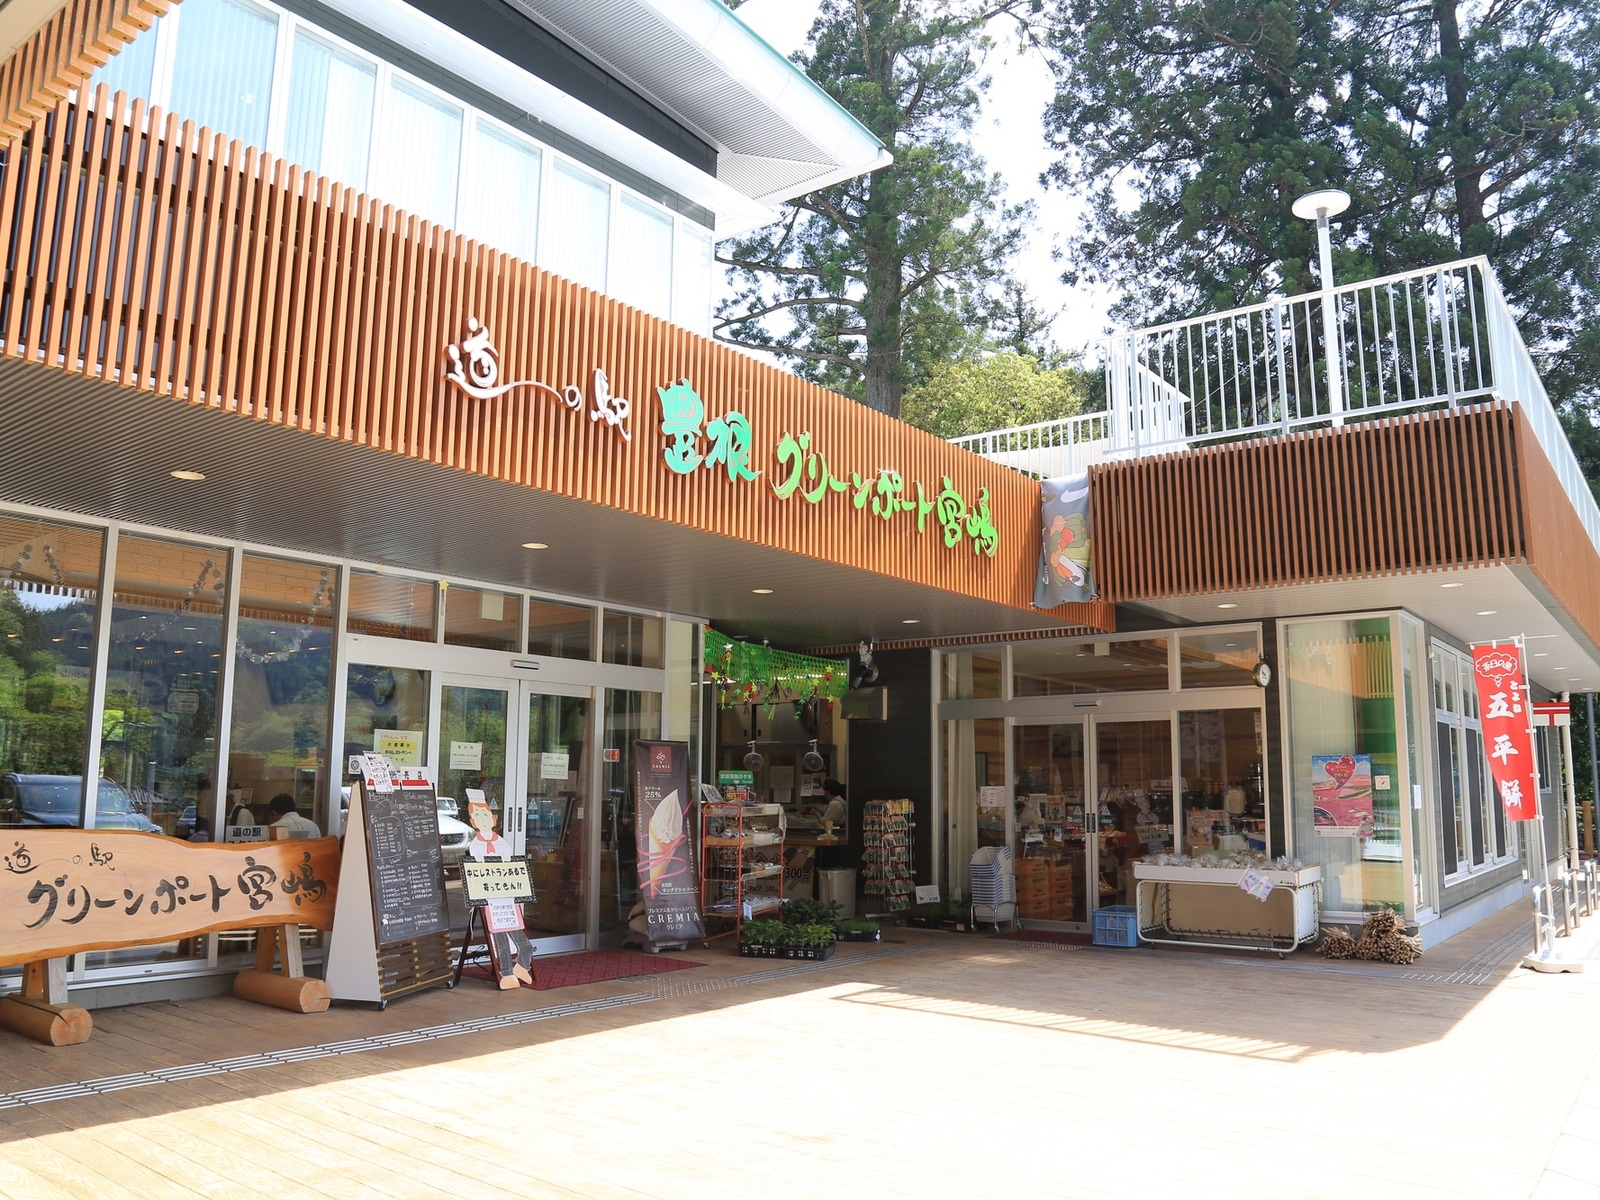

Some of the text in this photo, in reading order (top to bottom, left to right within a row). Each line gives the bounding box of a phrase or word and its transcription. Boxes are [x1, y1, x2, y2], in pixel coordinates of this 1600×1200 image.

[445, 317, 632, 442] 道の駅
[655, 377, 761, 482] 豊根
[1485, 691, 1523, 809] 五平餅
[645, 791, 662, 799] 25%
[232, 827, 261, 837] 道の駅
[5, 841, 115, 874] 道の駅
[467, 867, 526, 878] 中にレストランあるで
[648, 912, 700, 924] CREMIA
